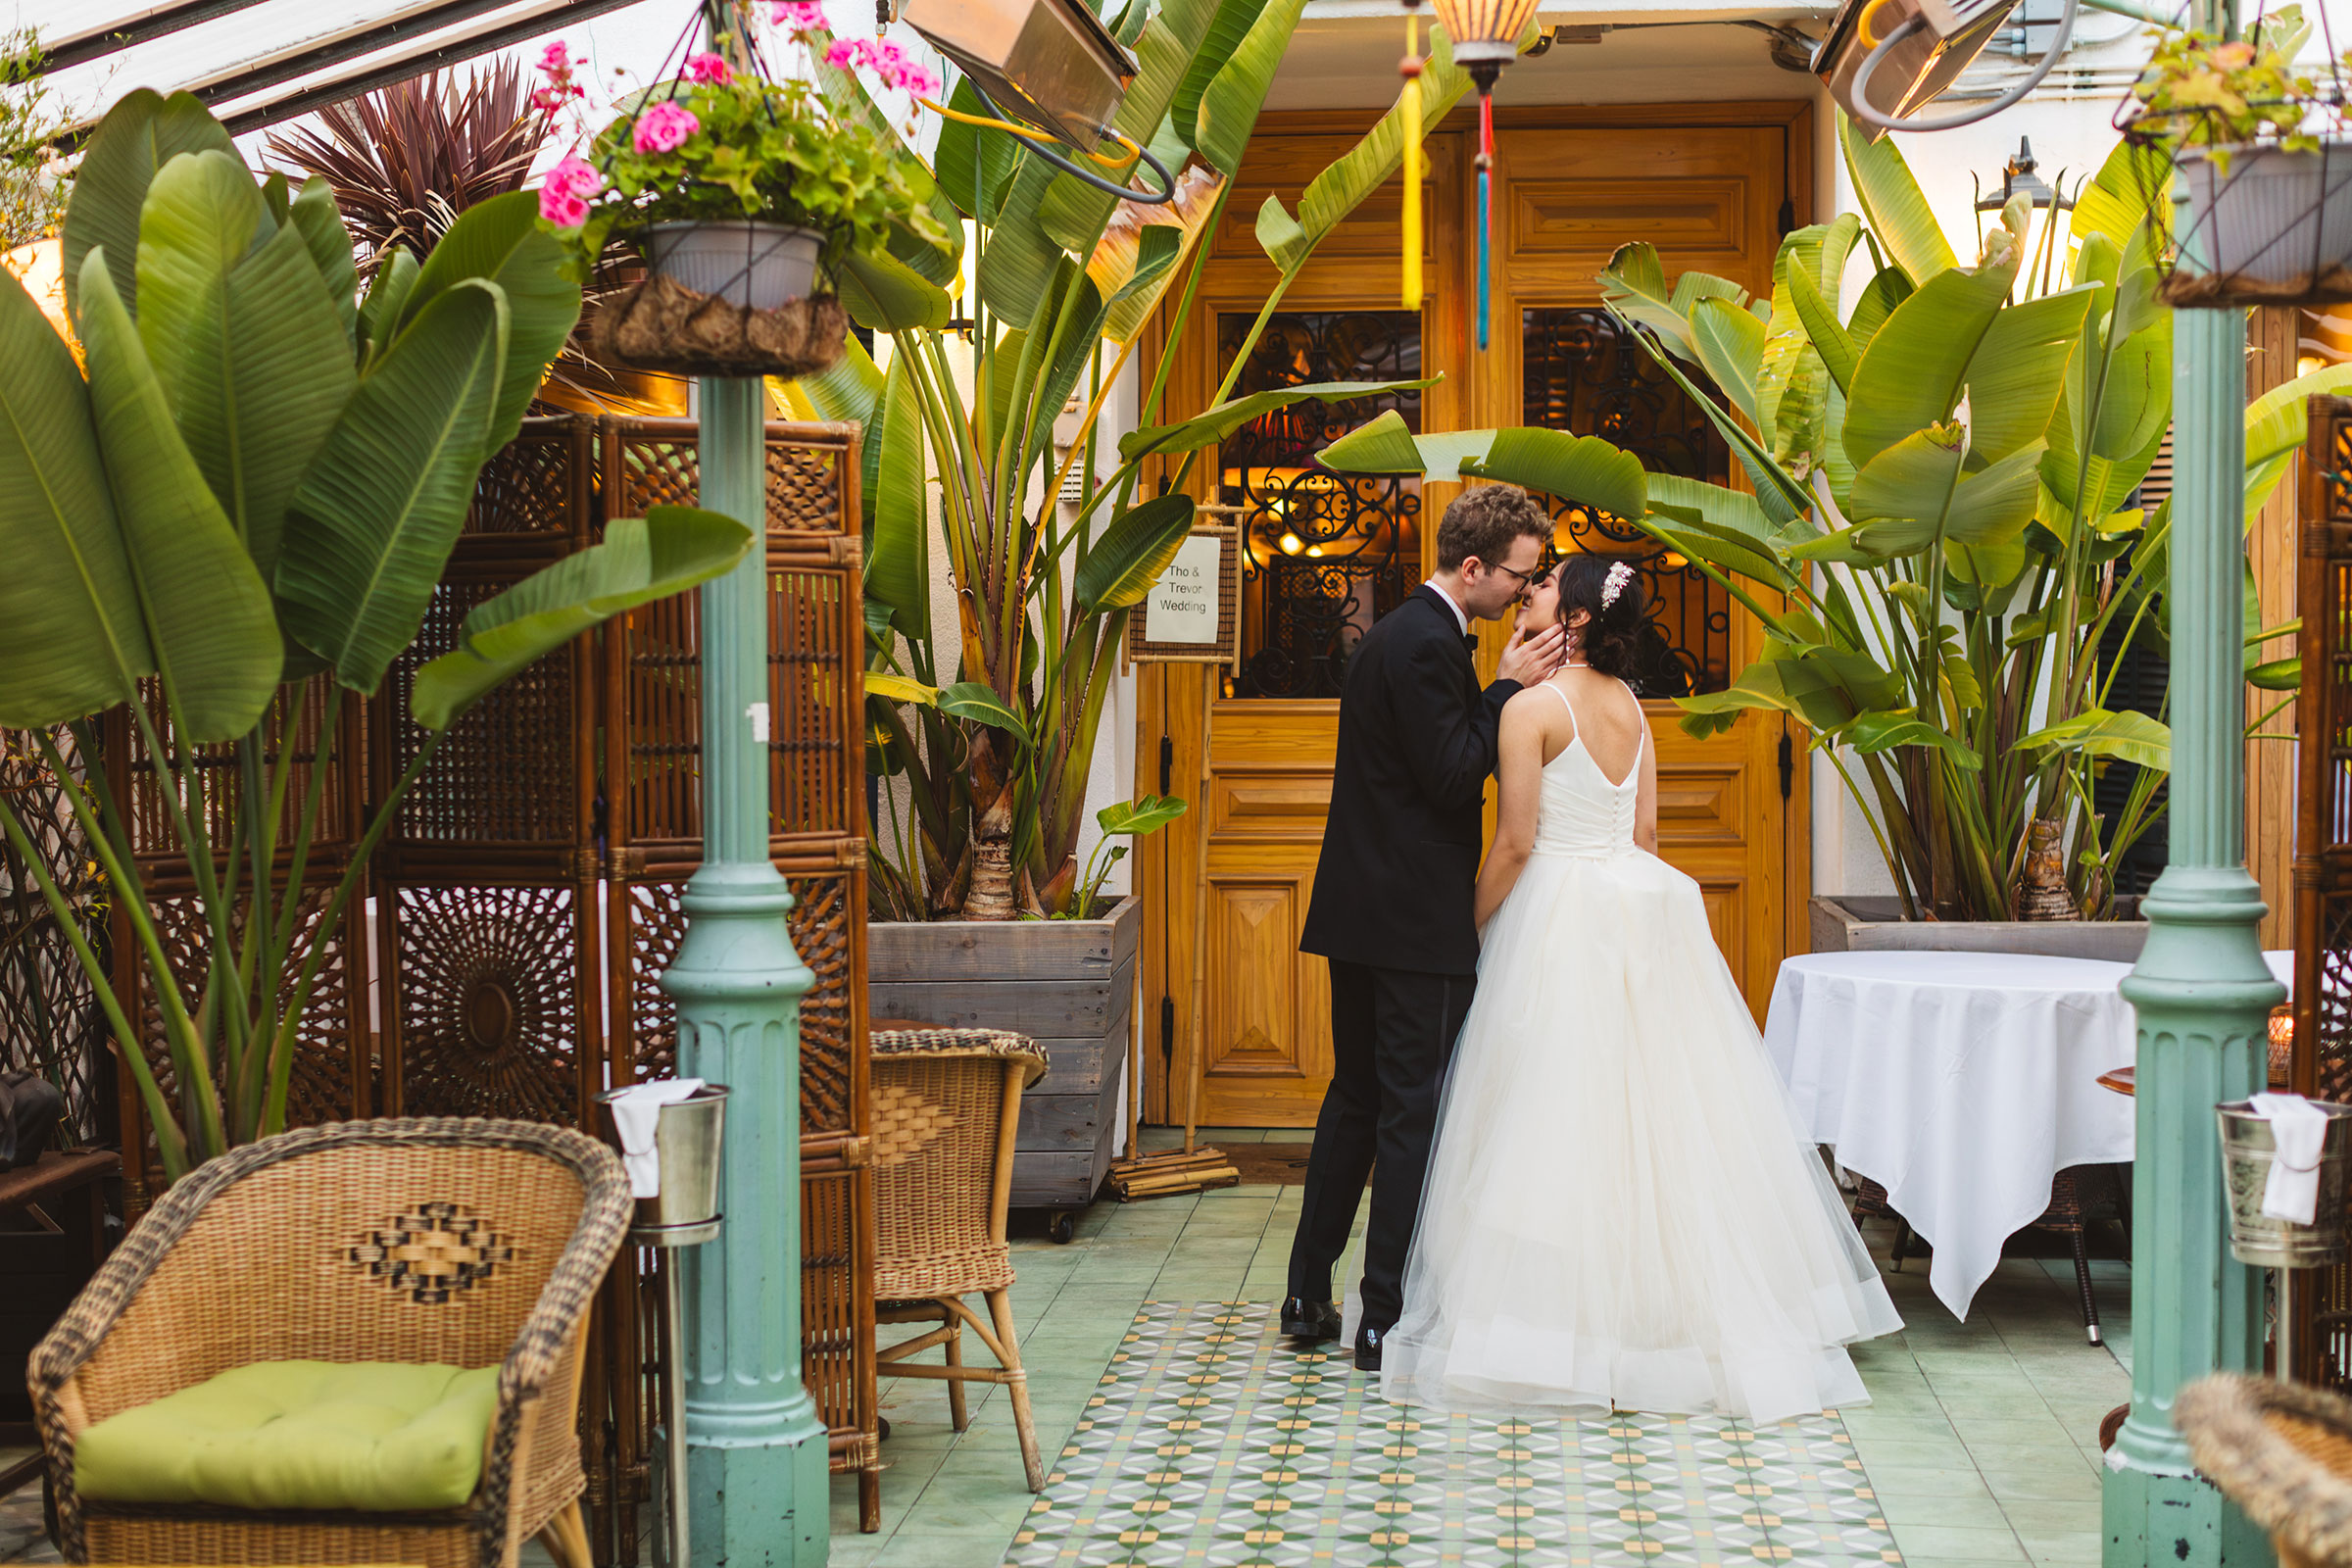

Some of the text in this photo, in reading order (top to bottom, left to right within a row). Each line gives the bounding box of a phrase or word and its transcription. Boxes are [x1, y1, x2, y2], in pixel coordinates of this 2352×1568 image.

[1169, 565, 1200, 577] Tho &
[1169, 582, 1202, 594] Trevor
[1160, 600, 1206, 614] Wedding
